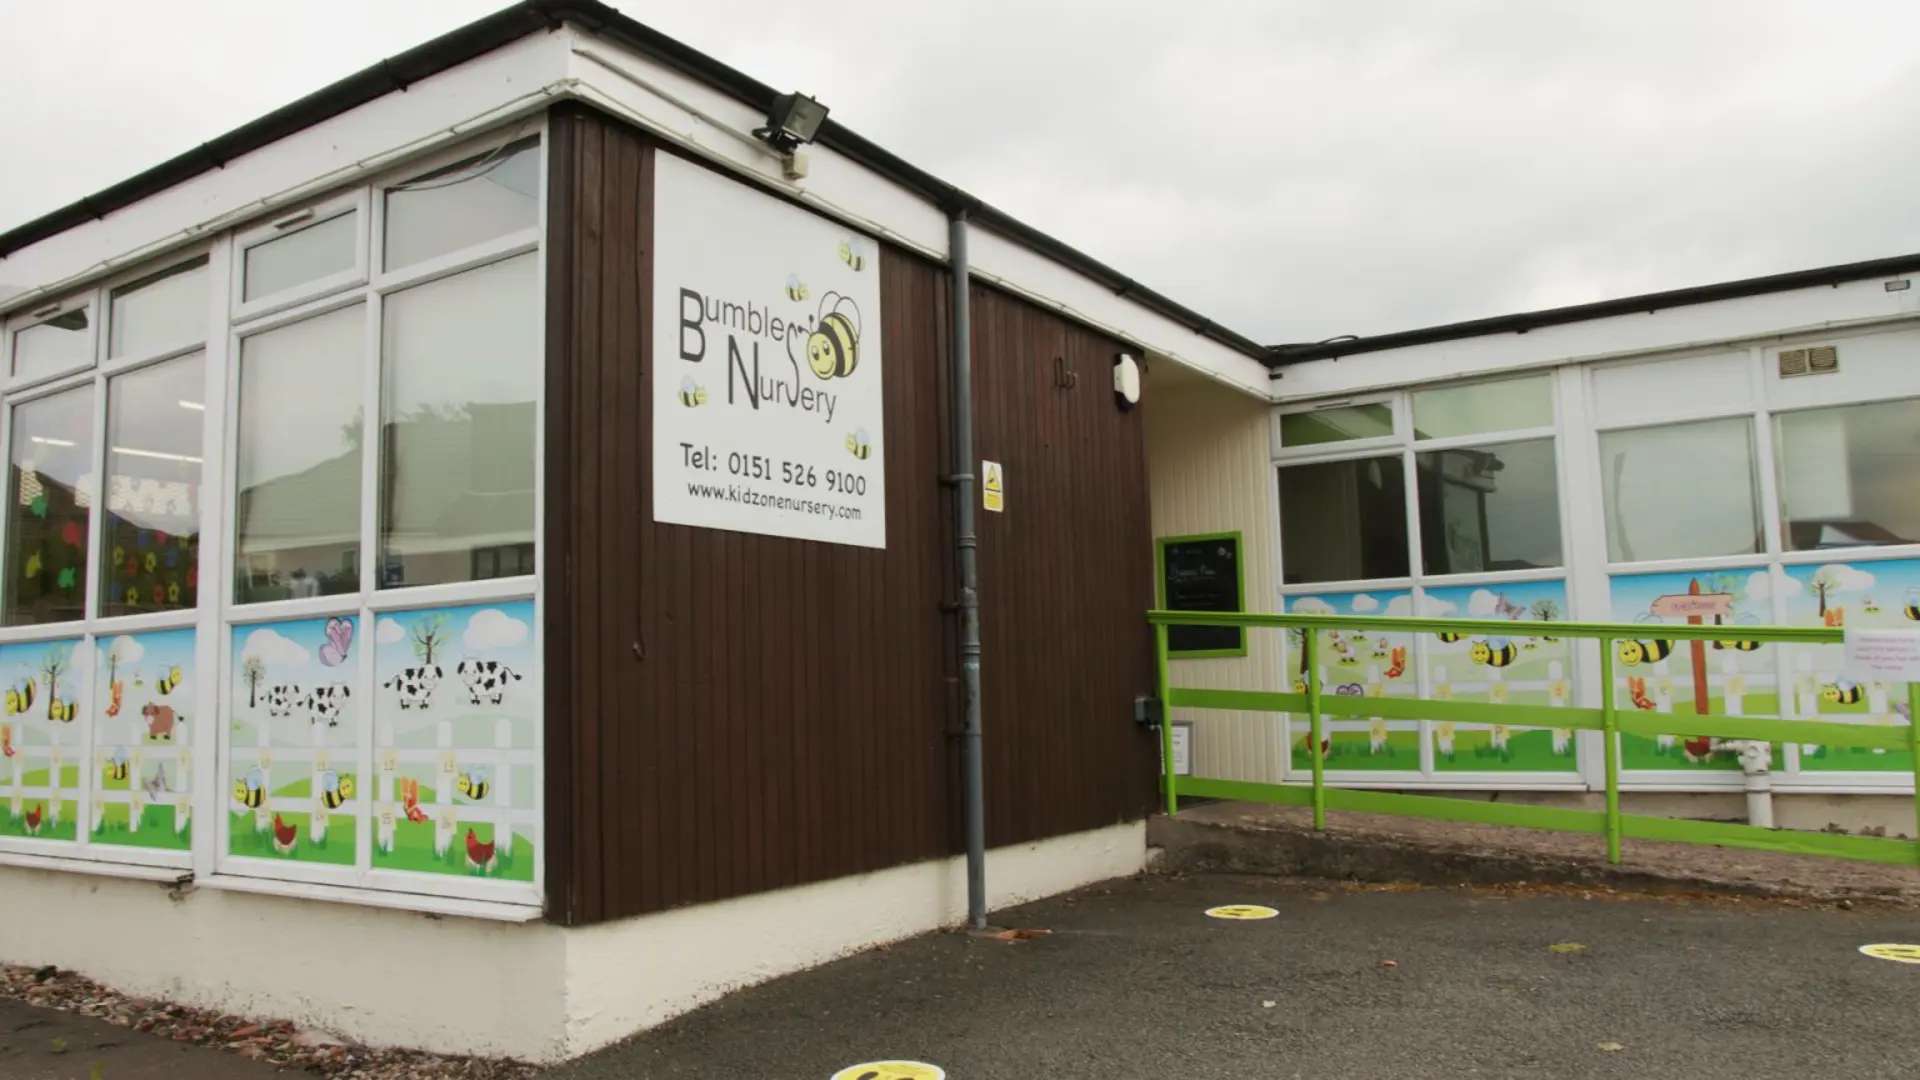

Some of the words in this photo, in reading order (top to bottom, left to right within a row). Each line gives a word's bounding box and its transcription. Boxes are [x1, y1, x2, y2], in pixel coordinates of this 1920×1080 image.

[680, 442, 718, 471] Tel:
[728, 452, 772, 481] 0151
[782, 461, 817, 488] 526
[825, 470, 867, 496] 9100
[687, 482, 862, 520] www.kidzonenursery.com
